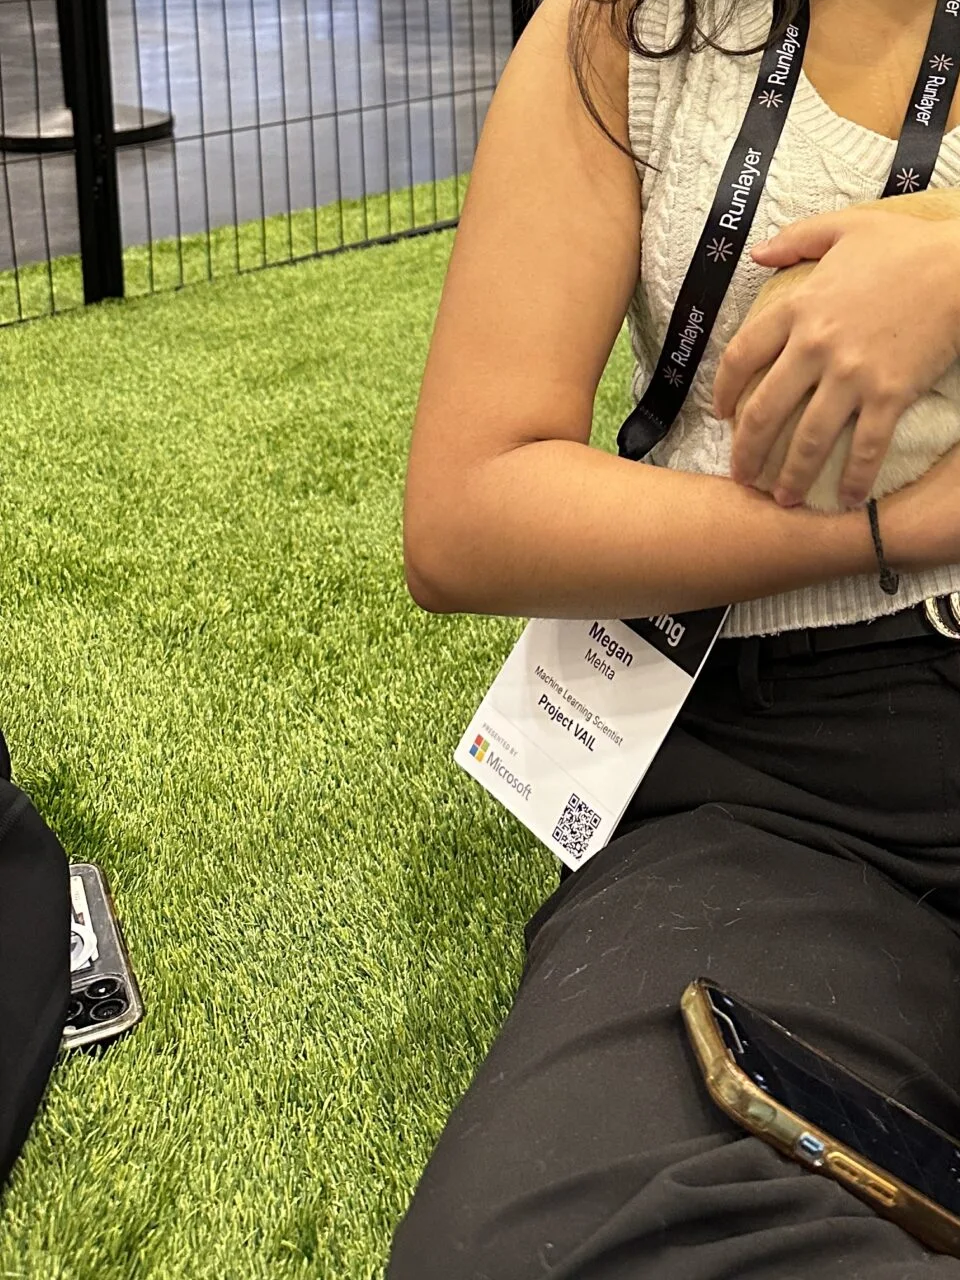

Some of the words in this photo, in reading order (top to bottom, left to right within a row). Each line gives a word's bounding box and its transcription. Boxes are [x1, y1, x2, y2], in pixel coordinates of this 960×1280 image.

[768, 24, 801, 86] Runlayer
[915, 75, 946, 126] Runlayer
[719, 147, 762, 231] Runlayer
[670, 305, 705, 367] Runlayer
[588, 621, 634, 667] Megan
[648, 614, 686, 647] ing
[584, 648, 616, 680] Mehta
[534, 665, 563, 695] Machine
[562, 689, 593, 722] Learning
[592, 715, 624, 747] Scientist
[537, 693, 574, 731] Project
[573, 723, 596, 752] VAIL
[482, 722, 511, 750] PRESENTED
[509, 747, 519, 757] BY
[486, 751, 532, 801] Microsoft
